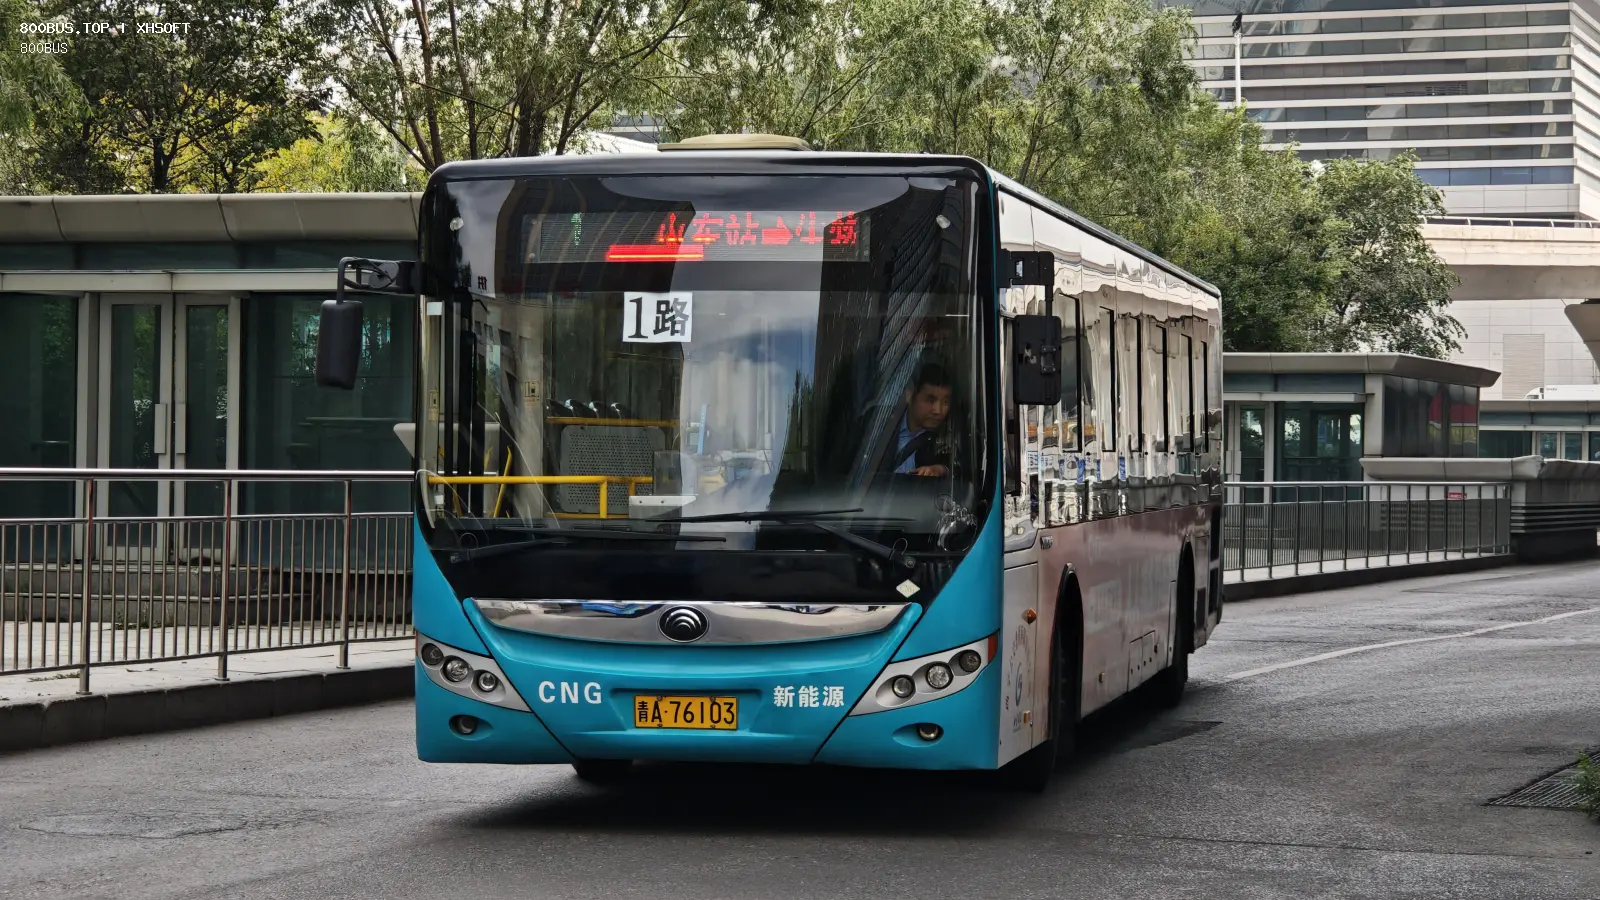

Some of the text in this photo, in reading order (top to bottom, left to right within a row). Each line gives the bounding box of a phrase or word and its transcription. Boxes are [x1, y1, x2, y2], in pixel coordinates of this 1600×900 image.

[628, 296, 689, 339] 1路
[538, 681, 602, 704] CNG
[773, 685, 846, 708] 新能源
[637, 700, 735, 725] 青A·76103
